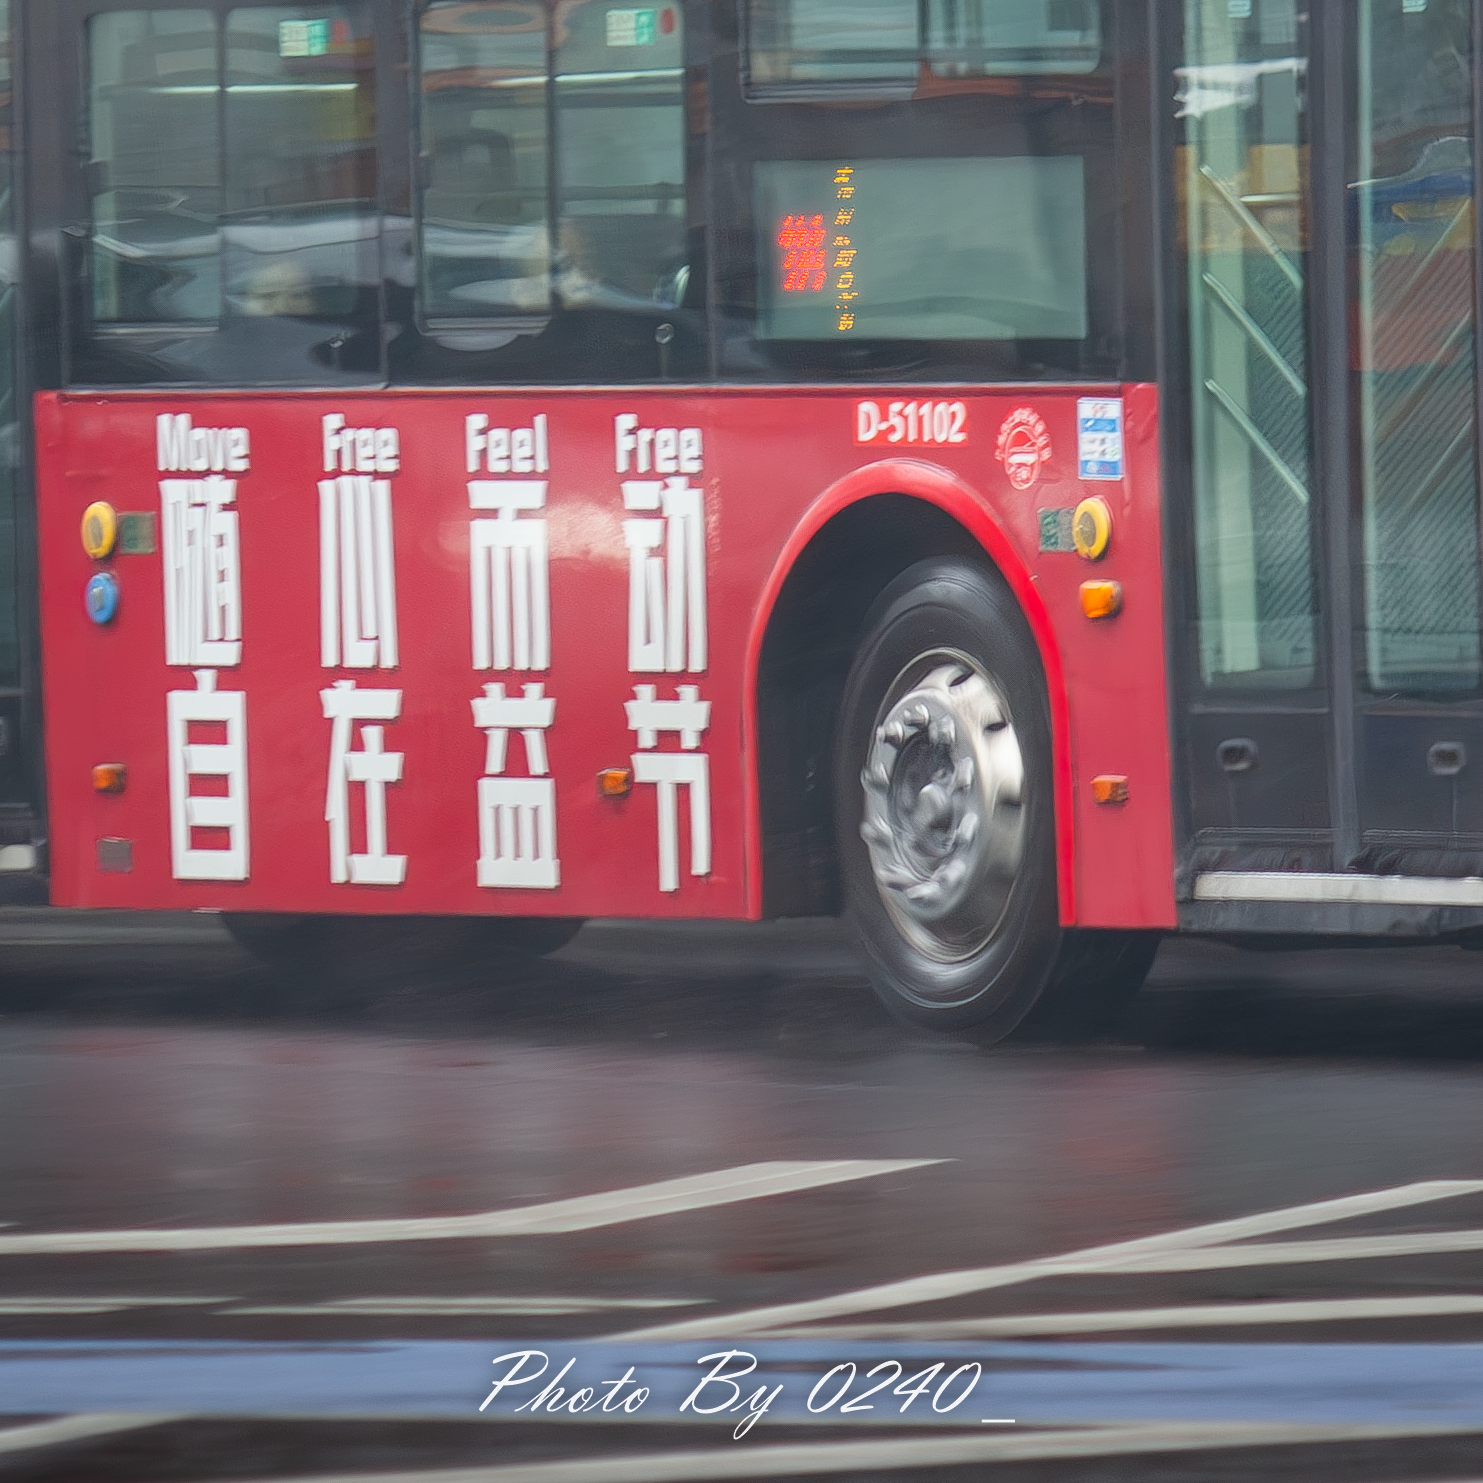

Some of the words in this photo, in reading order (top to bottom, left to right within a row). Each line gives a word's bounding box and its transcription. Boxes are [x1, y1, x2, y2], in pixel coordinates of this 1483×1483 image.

[156, 413, 250, 471] Move
[322, 413, 400, 473] Free
[466, 413, 548, 473] Feel
[615, 413, 704, 473] Free
[856, 402, 967, 443] D-51102
